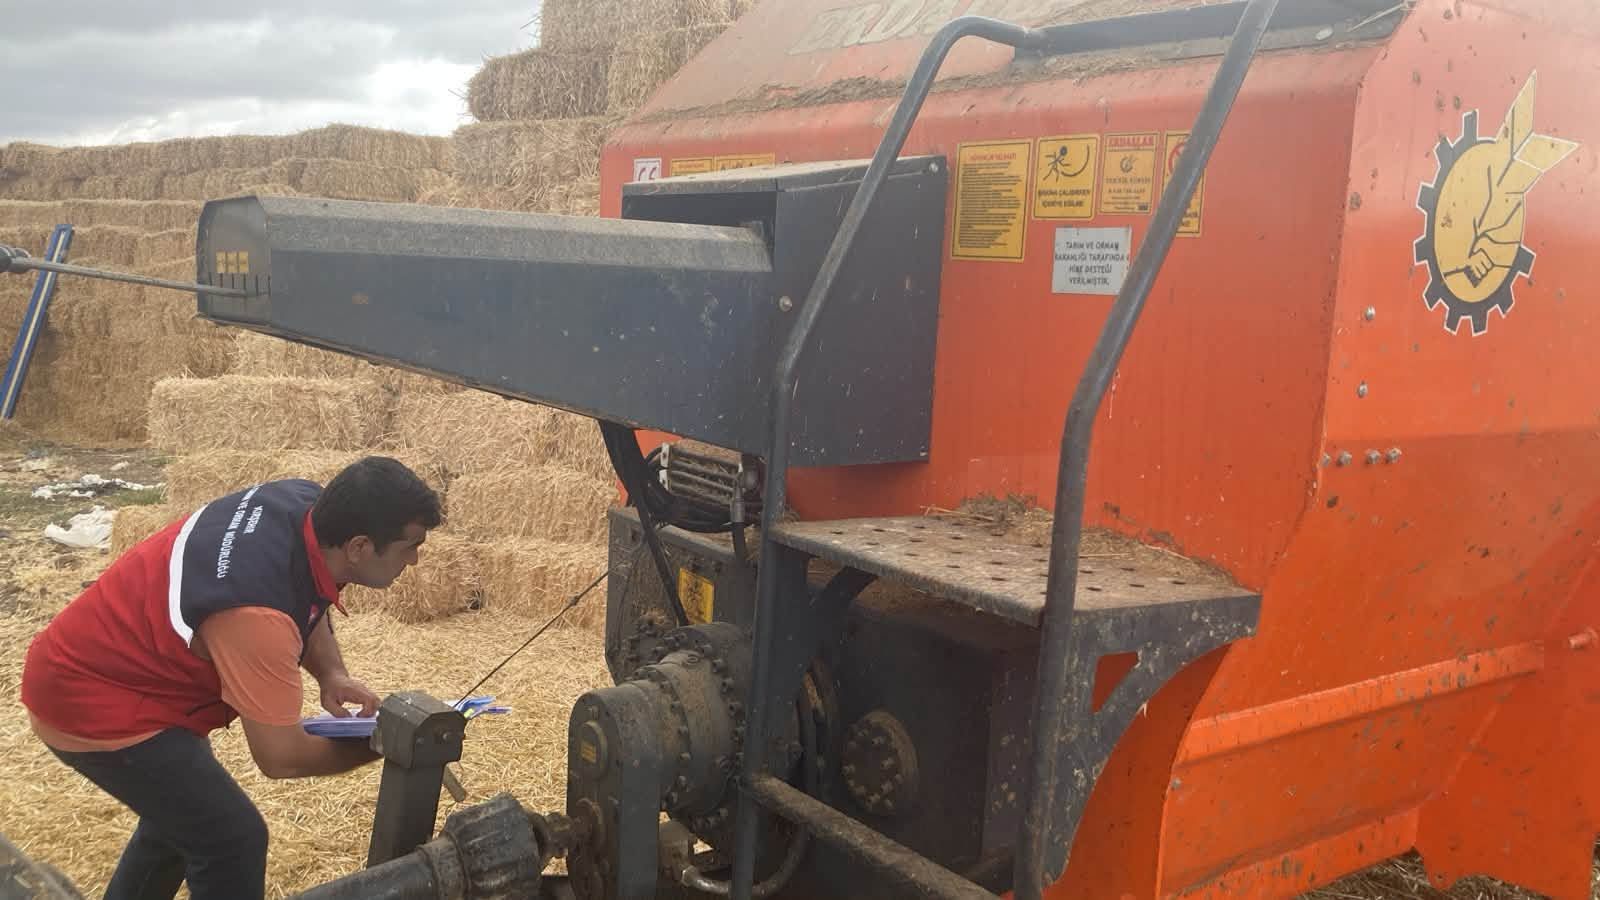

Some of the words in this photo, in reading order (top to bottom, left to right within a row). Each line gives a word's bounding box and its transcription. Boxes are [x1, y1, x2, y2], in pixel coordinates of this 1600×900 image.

[1065, 241, 1084, 249] TARIM
[1086, 241, 1094, 249] VE
[1096, 241, 1119, 250] ORMAN
[217, 531, 236, 579] MÜDÜRLÜĞÜ
